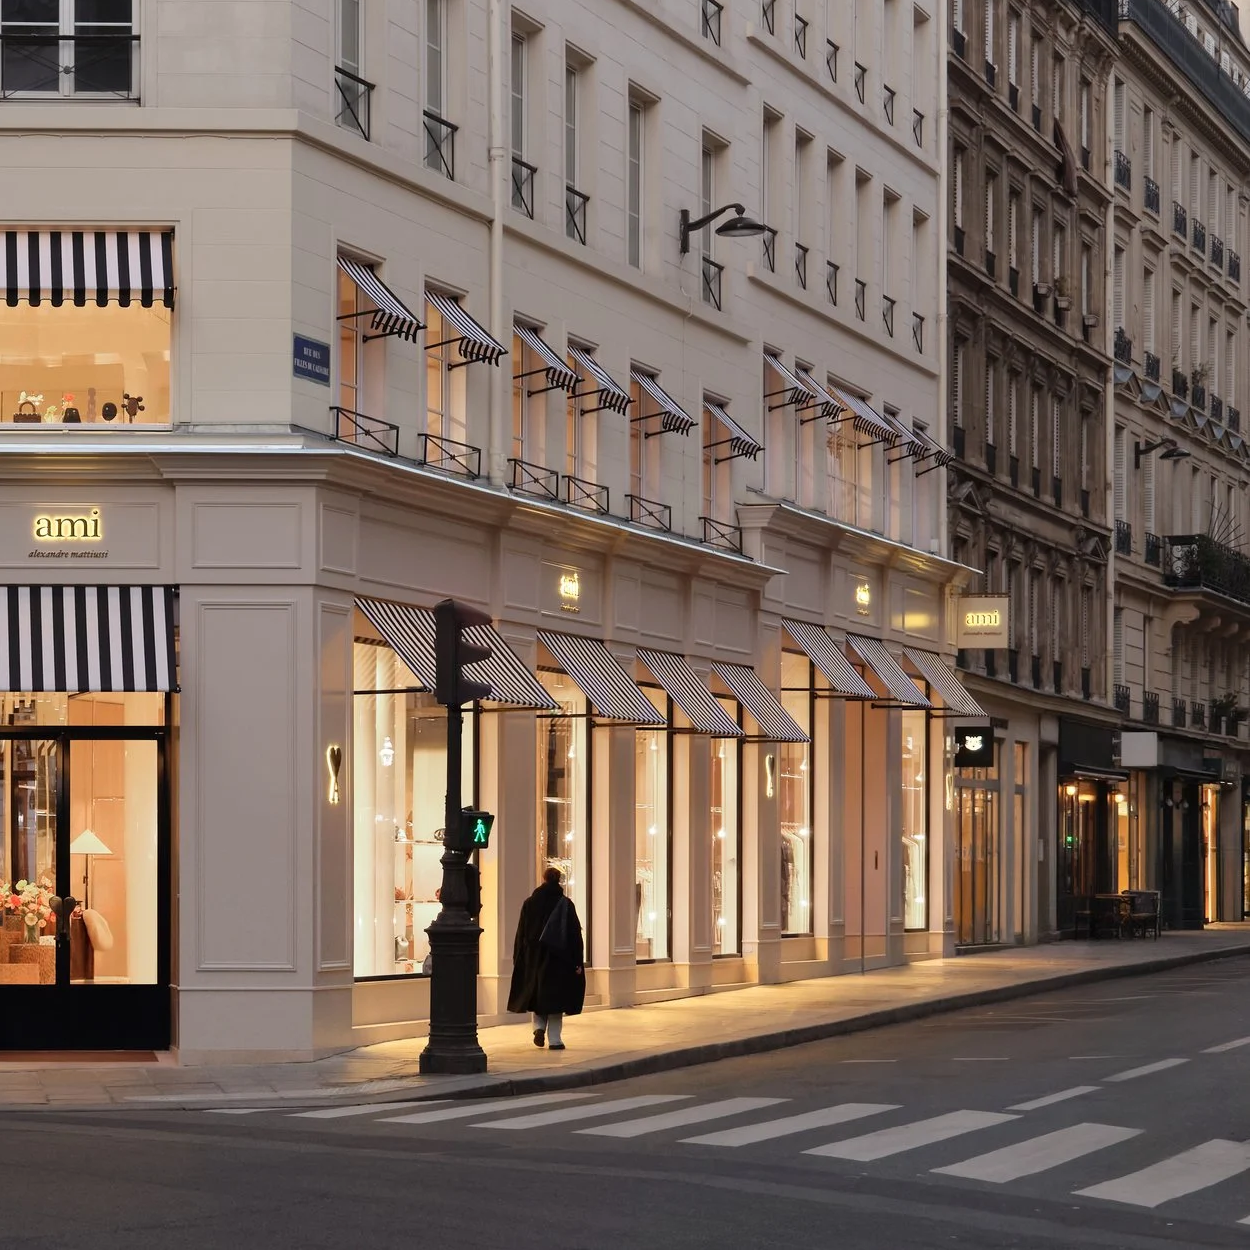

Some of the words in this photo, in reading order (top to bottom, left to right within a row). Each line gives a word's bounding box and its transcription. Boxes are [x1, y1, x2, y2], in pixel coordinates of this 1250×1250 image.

[35, 510, 101, 538] ami
[28, 549, 69, 559] alexandre
[966, 609, 998, 625] ami
